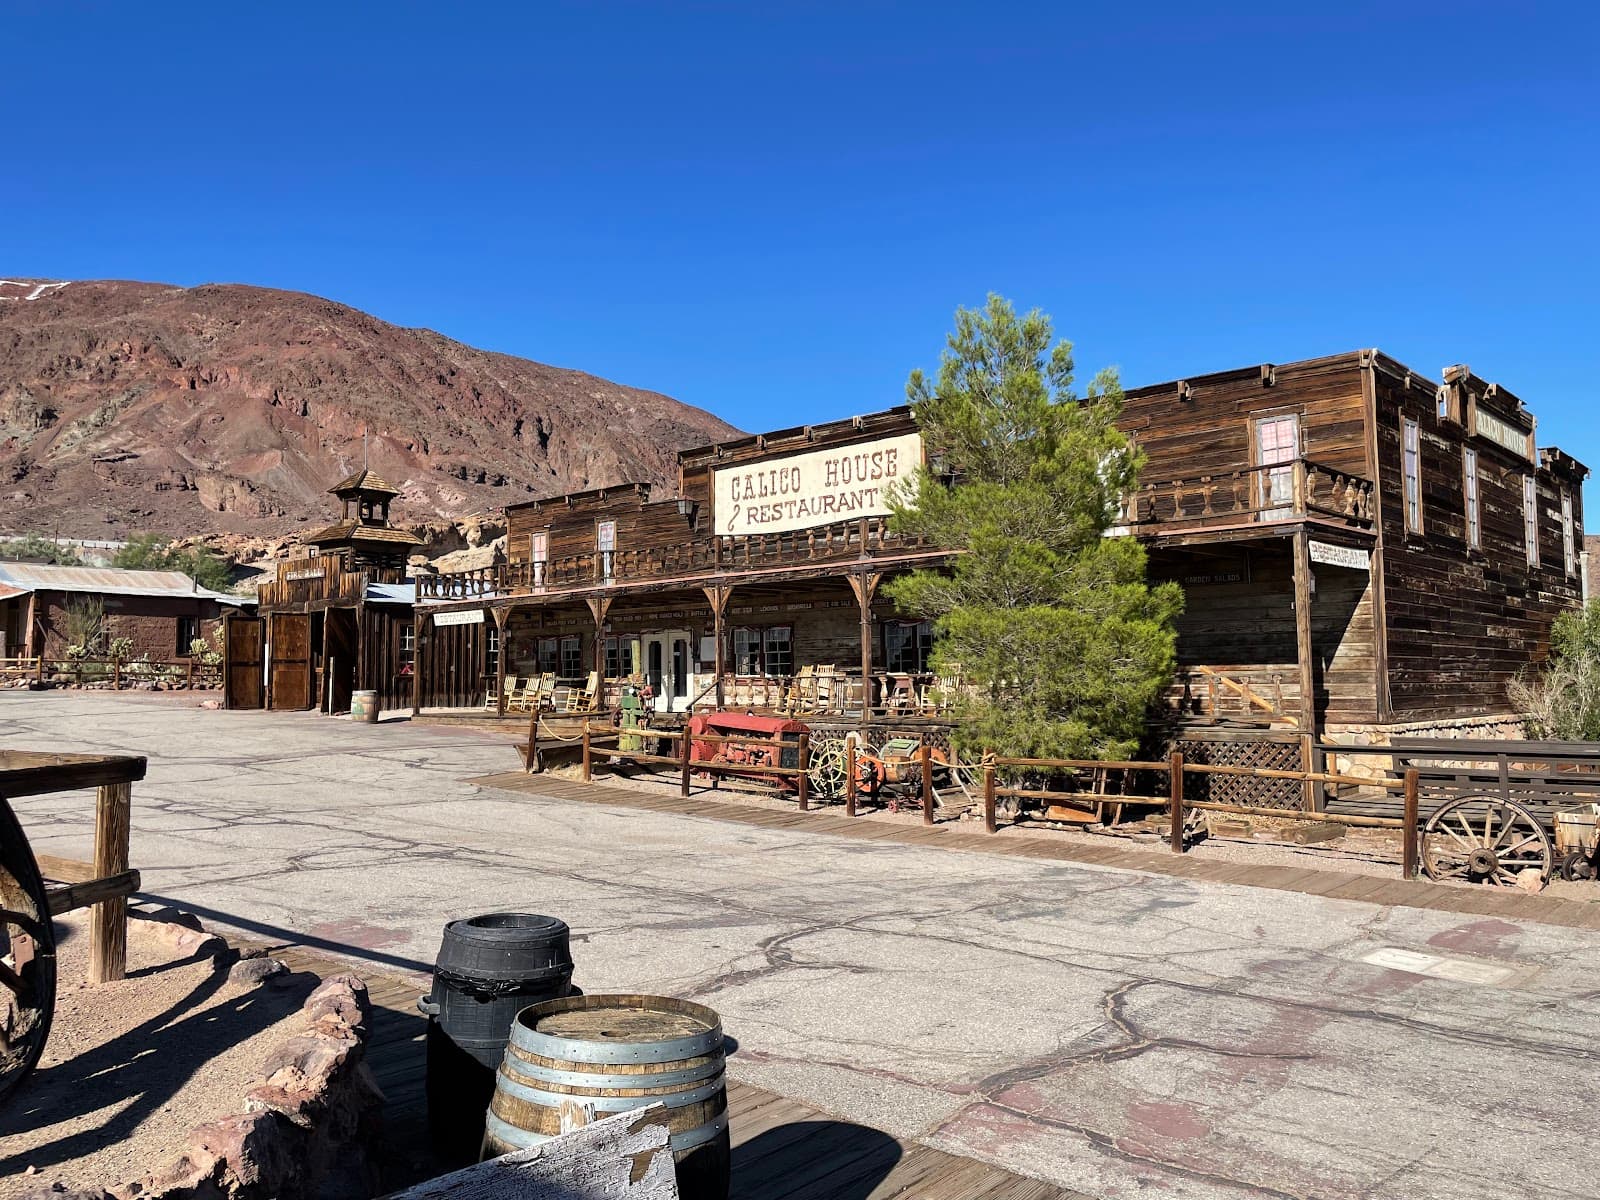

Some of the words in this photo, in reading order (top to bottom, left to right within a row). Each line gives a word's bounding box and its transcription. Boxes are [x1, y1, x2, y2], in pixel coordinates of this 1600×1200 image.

[731, 466, 801, 502] CALICO
[824, 448, 898, 487] HOUSE
[746, 487, 878, 525] RESTAURANT
